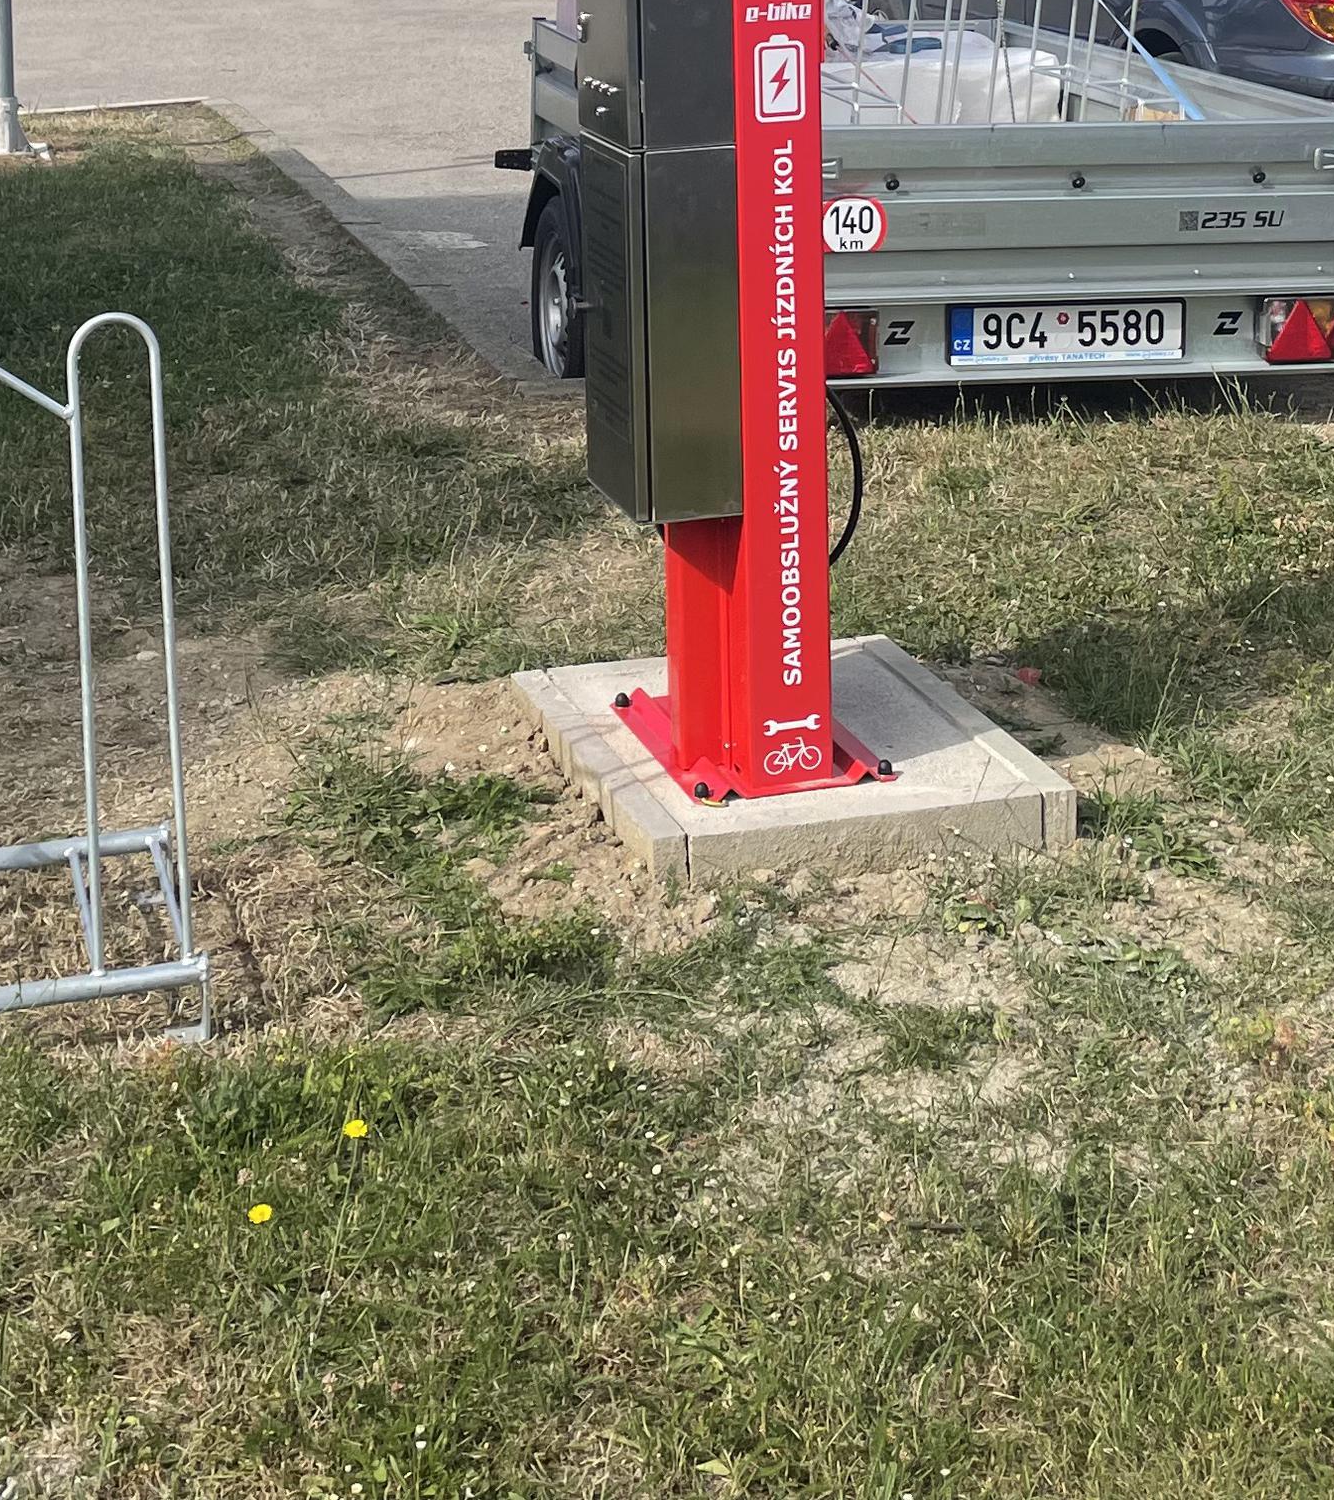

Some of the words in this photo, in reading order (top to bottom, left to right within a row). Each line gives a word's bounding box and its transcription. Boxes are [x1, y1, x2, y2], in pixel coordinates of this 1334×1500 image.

[745, 2, 812, 23] e-bike
[774, 139, 794, 195] KOL
[830, 205, 873, 235] 140
[1201, 211, 1247, 229] 235
[1253, 210, 1285, 228] SU
[839, 237, 863, 250] km
[768, 204, 797, 340] JÍZDNÍCH
[983, 312, 1048, 350] 9C4
[1078, 309, 1165, 347] 5580
[953, 339, 971, 351] CZ
[1061, 351, 1106, 362] TANATECH
[777, 348, 798, 451] SERVIS
[774, 460, 803, 686] SAMOOBSLUŽNÝ
